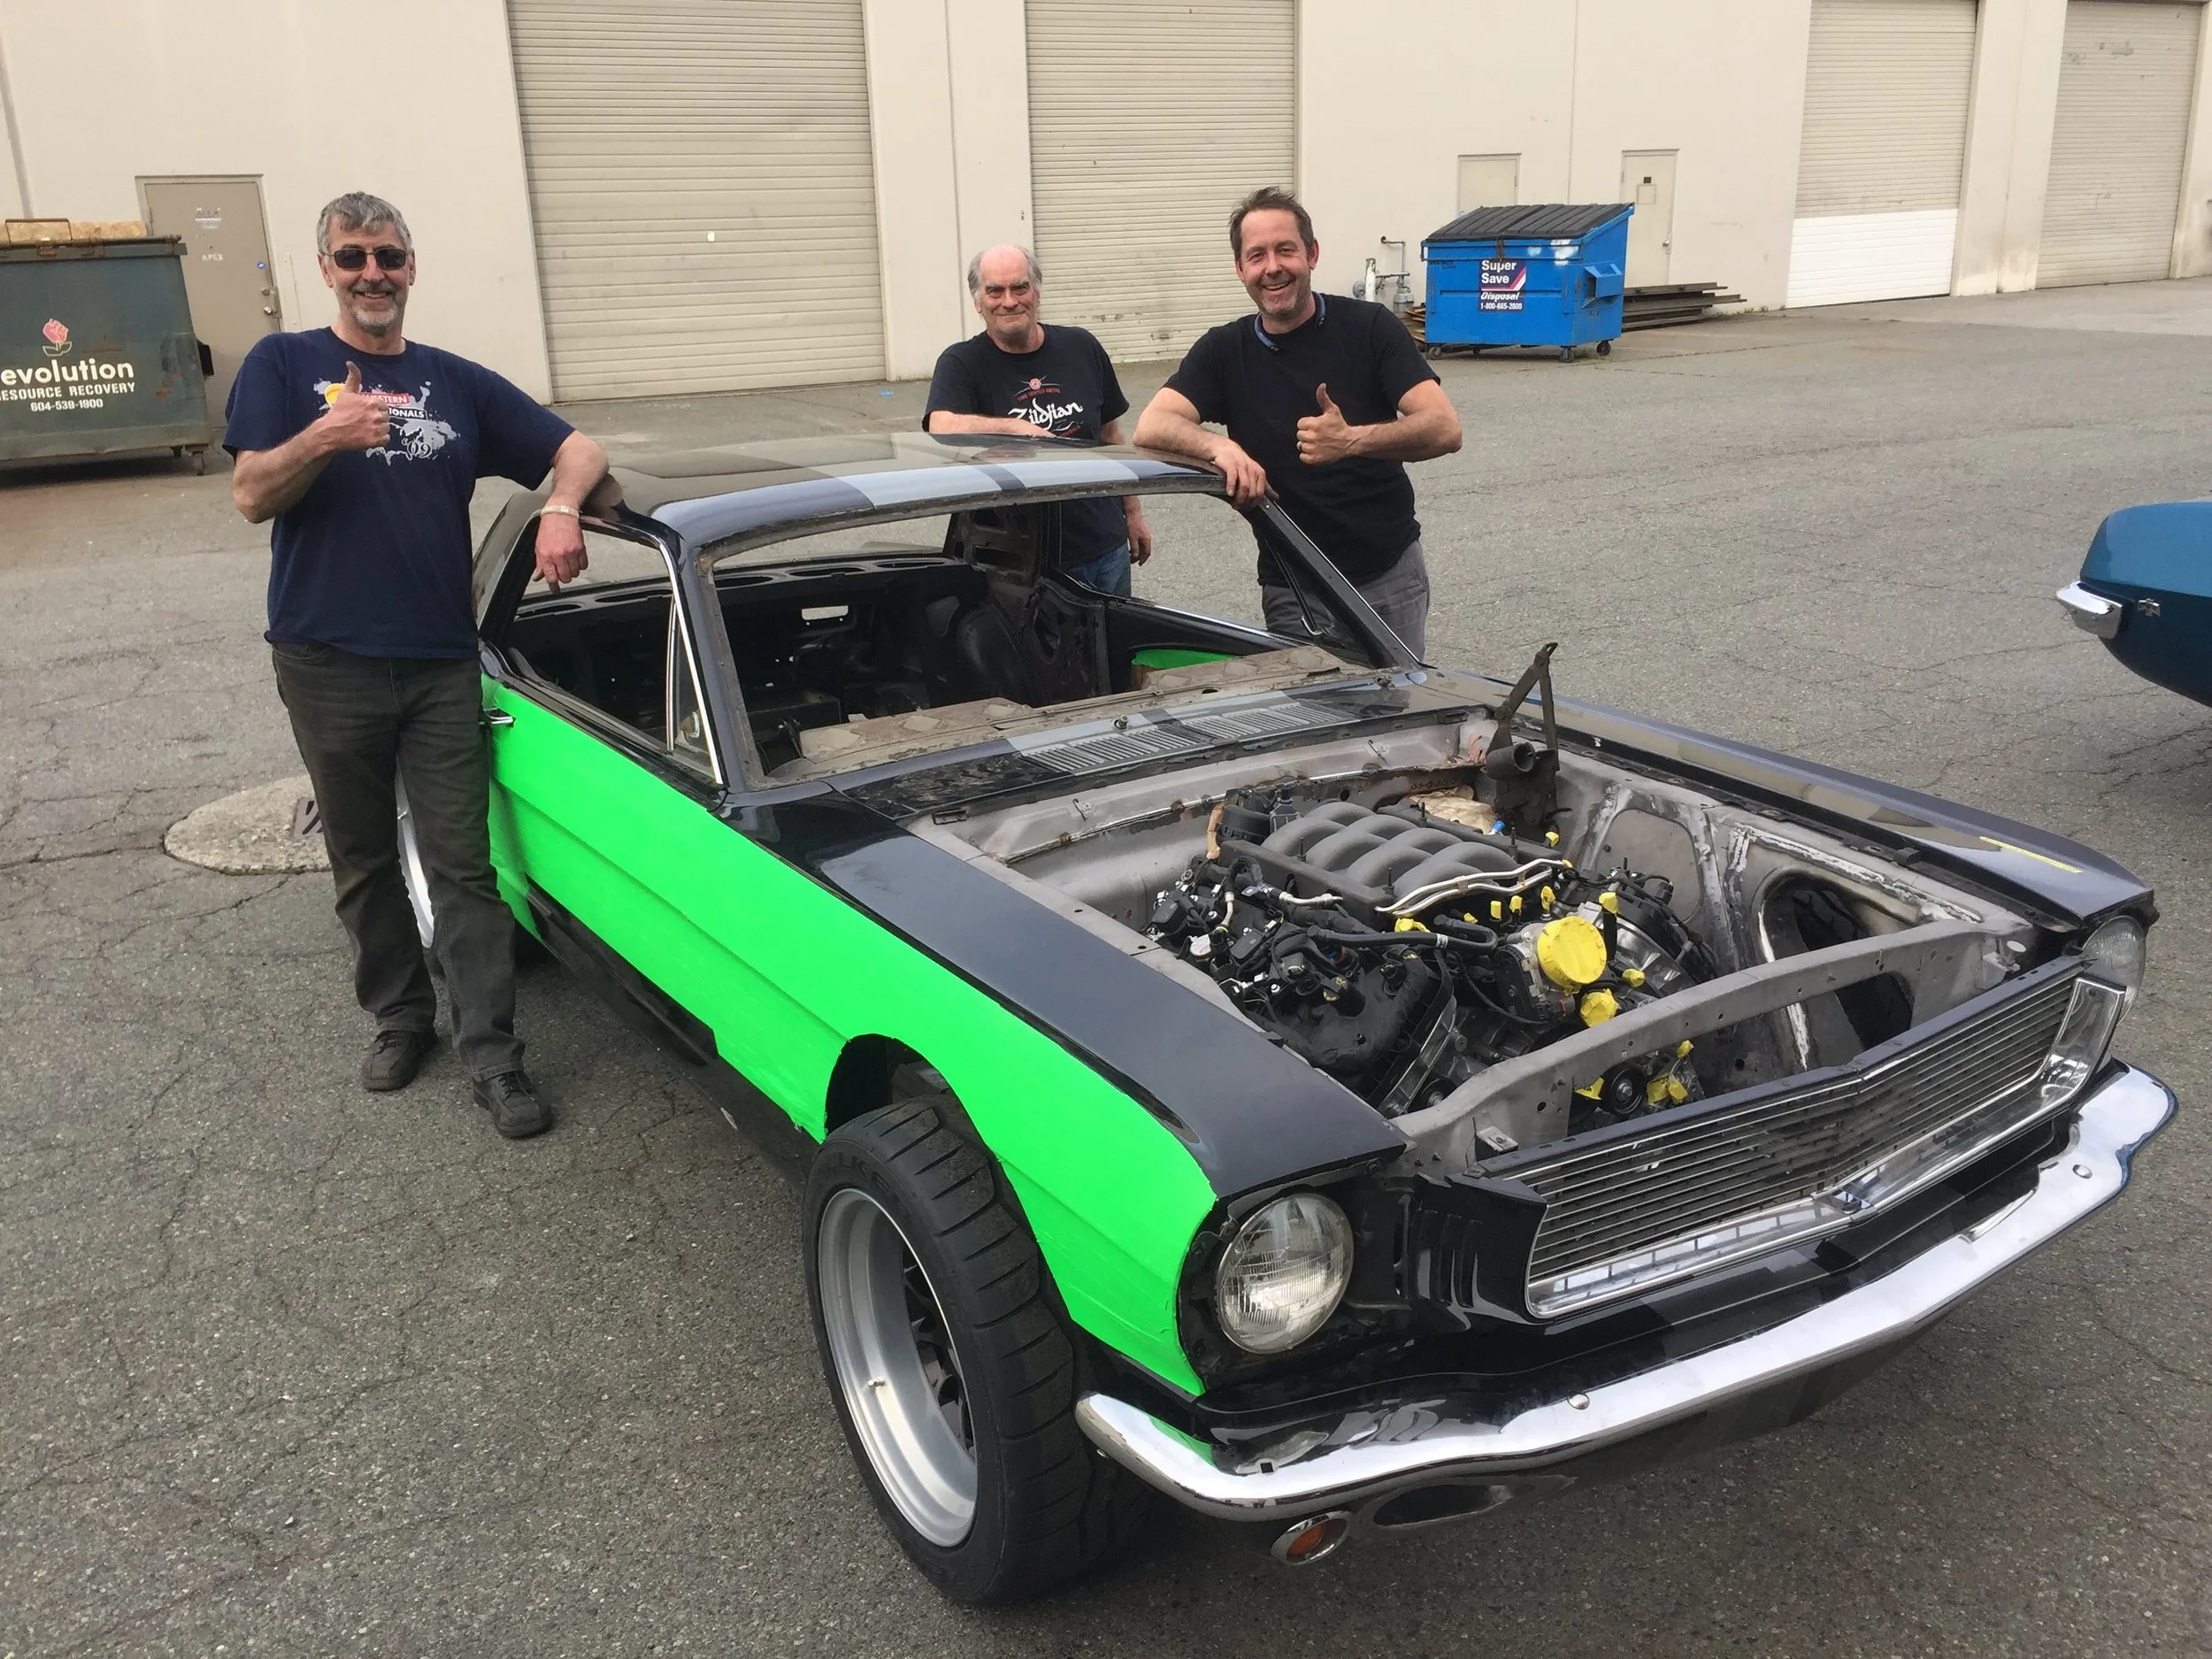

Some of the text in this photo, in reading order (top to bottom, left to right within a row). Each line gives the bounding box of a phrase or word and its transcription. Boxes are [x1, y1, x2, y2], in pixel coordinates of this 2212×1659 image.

[1481, 259, 1517, 273] Super
[1481, 273, 1509, 284] Save
[1480, 291, 1520, 303] Disposal
[0, 357, 134, 386] evolution
[0, 381, 135, 401] ESOURCE RECOVERY
[30, 398, 104, 412] 604-539-1900
[389, 408, 425, 418] IONALS
[1008, 397, 1084, 431] Zildjian
